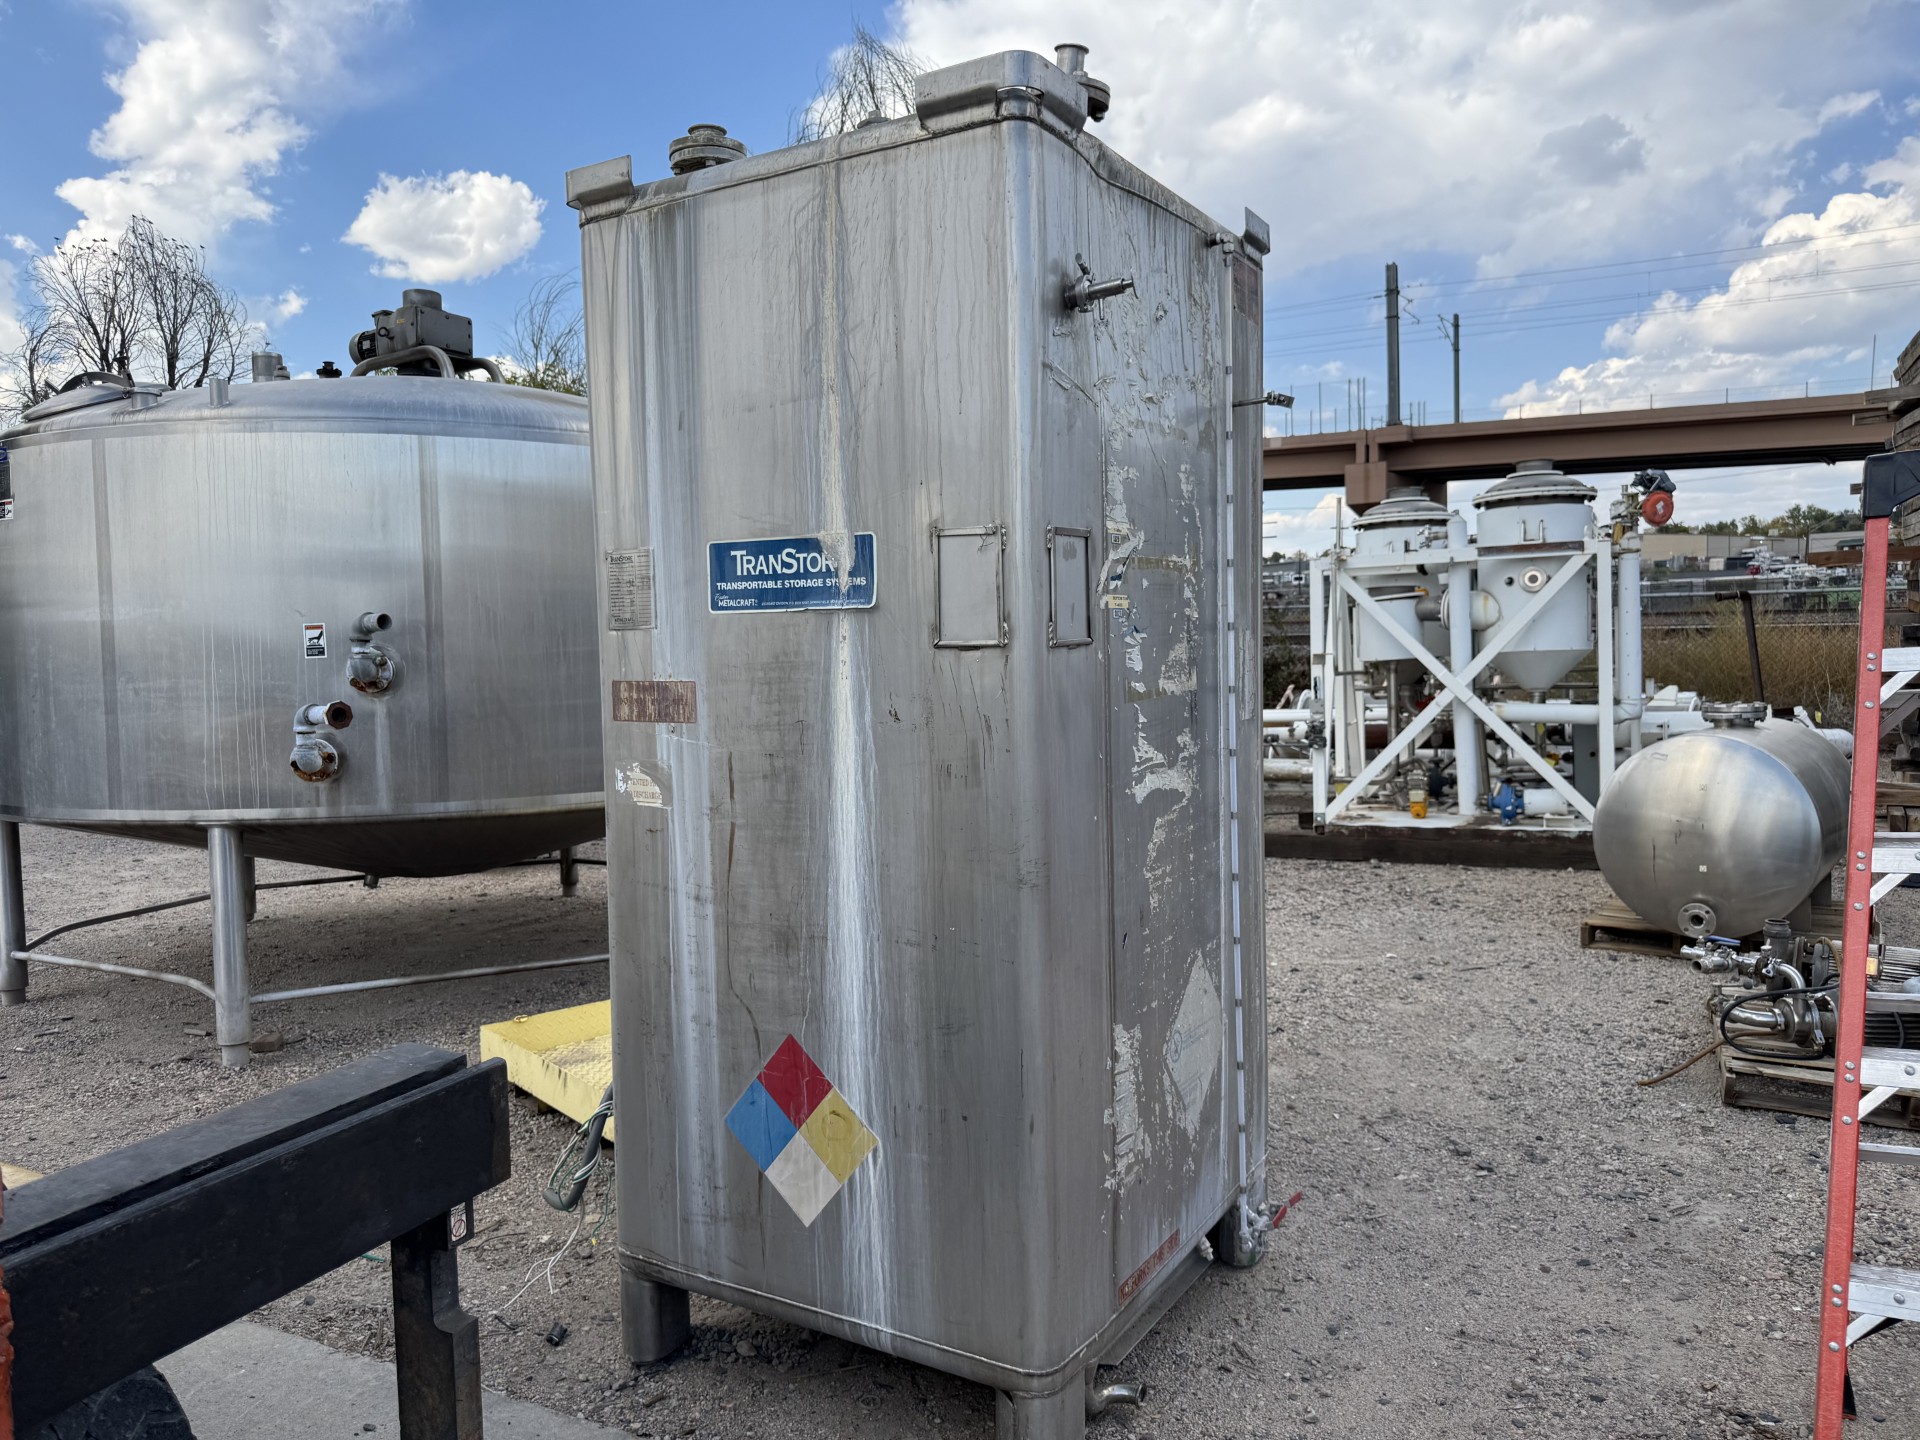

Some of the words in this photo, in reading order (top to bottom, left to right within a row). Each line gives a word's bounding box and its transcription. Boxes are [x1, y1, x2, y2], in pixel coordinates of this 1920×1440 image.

[730, 548, 844, 576] TRANSTOR
[716, 580, 783, 591] TRANSPORTABLE
[784, 578, 823, 588] STORAGE
[825, 577, 867, 587] SYSEMS
[630, 778, 649, 787] ENTED
